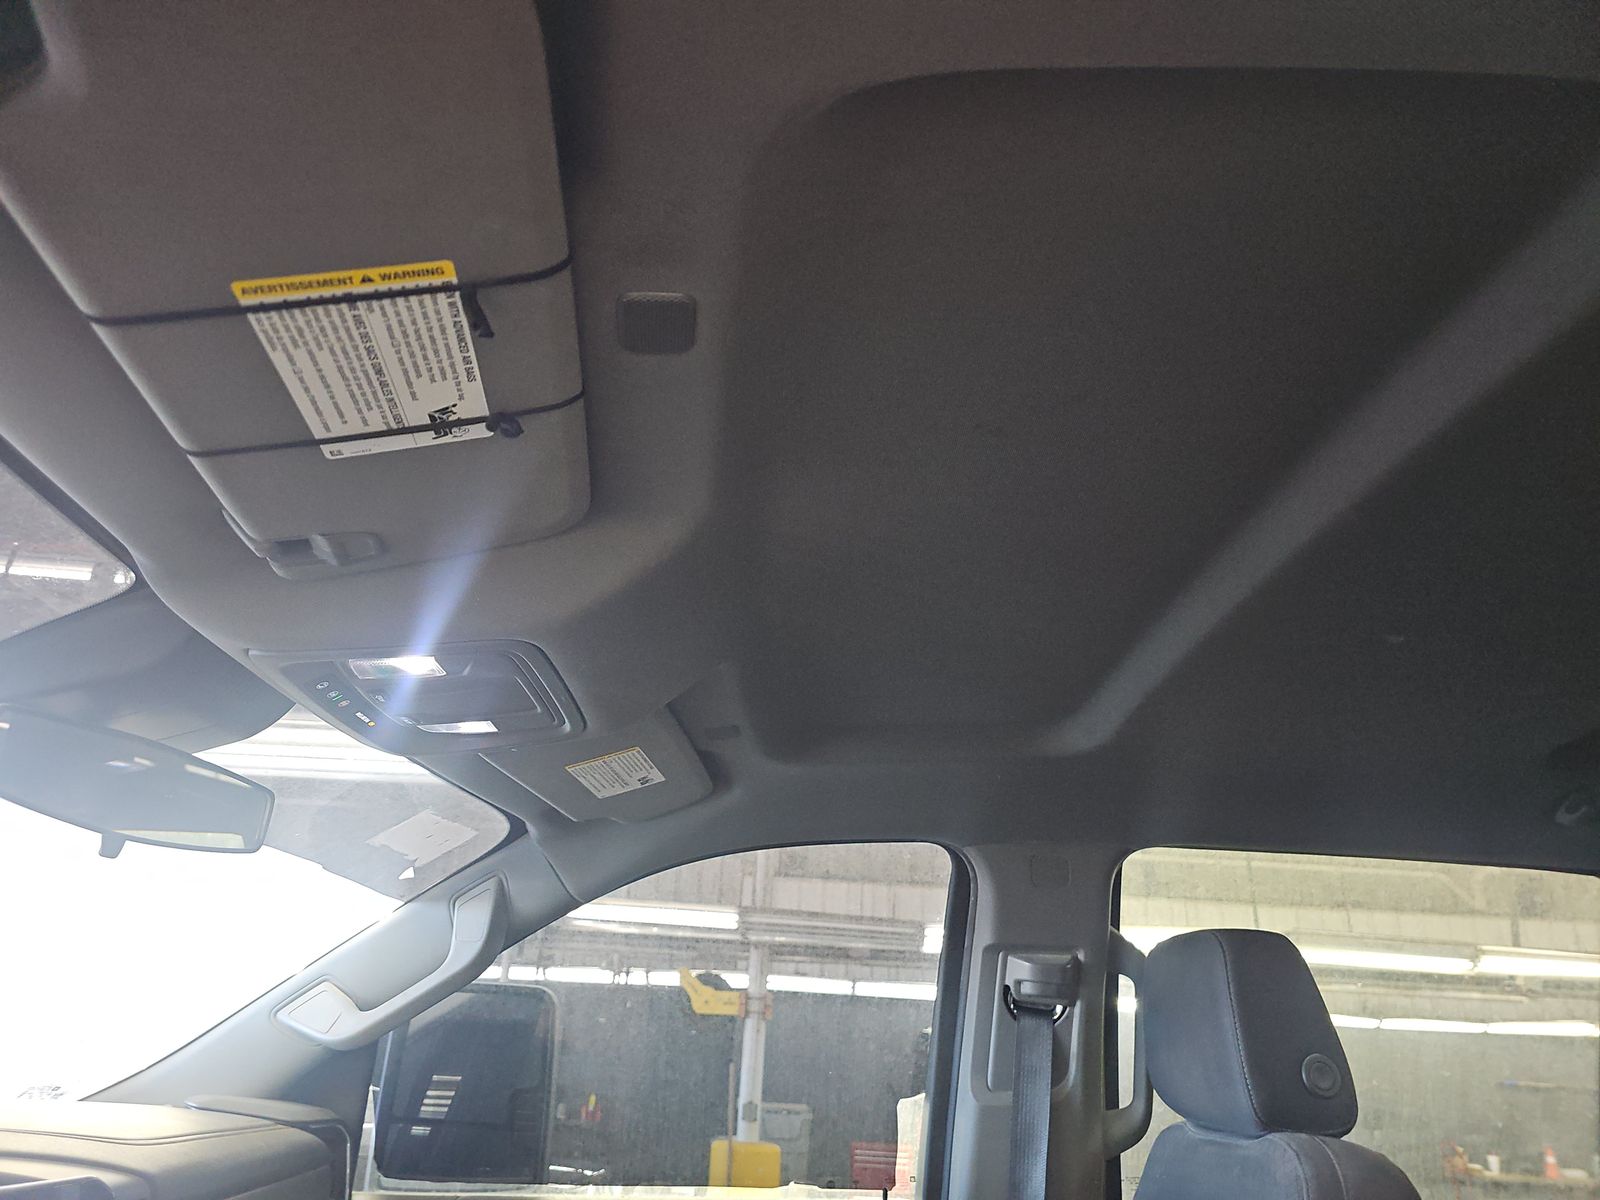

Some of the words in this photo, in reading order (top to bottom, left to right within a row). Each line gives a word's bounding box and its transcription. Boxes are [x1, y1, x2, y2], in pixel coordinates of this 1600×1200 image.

[241, 276, 354, 295] AVERTISSEMENT
[379, 266, 445, 281] WARNING
[448, 300, 460, 318] WITH
[359, 331, 372, 343] DES
[453, 320, 469, 353] ADVANCED
[364, 344, 378, 360] SACS
[462, 355, 472, 365] AIR
[465, 366, 476, 382] BAGS
[386, 397, 404, 428] INTELLIGENT
